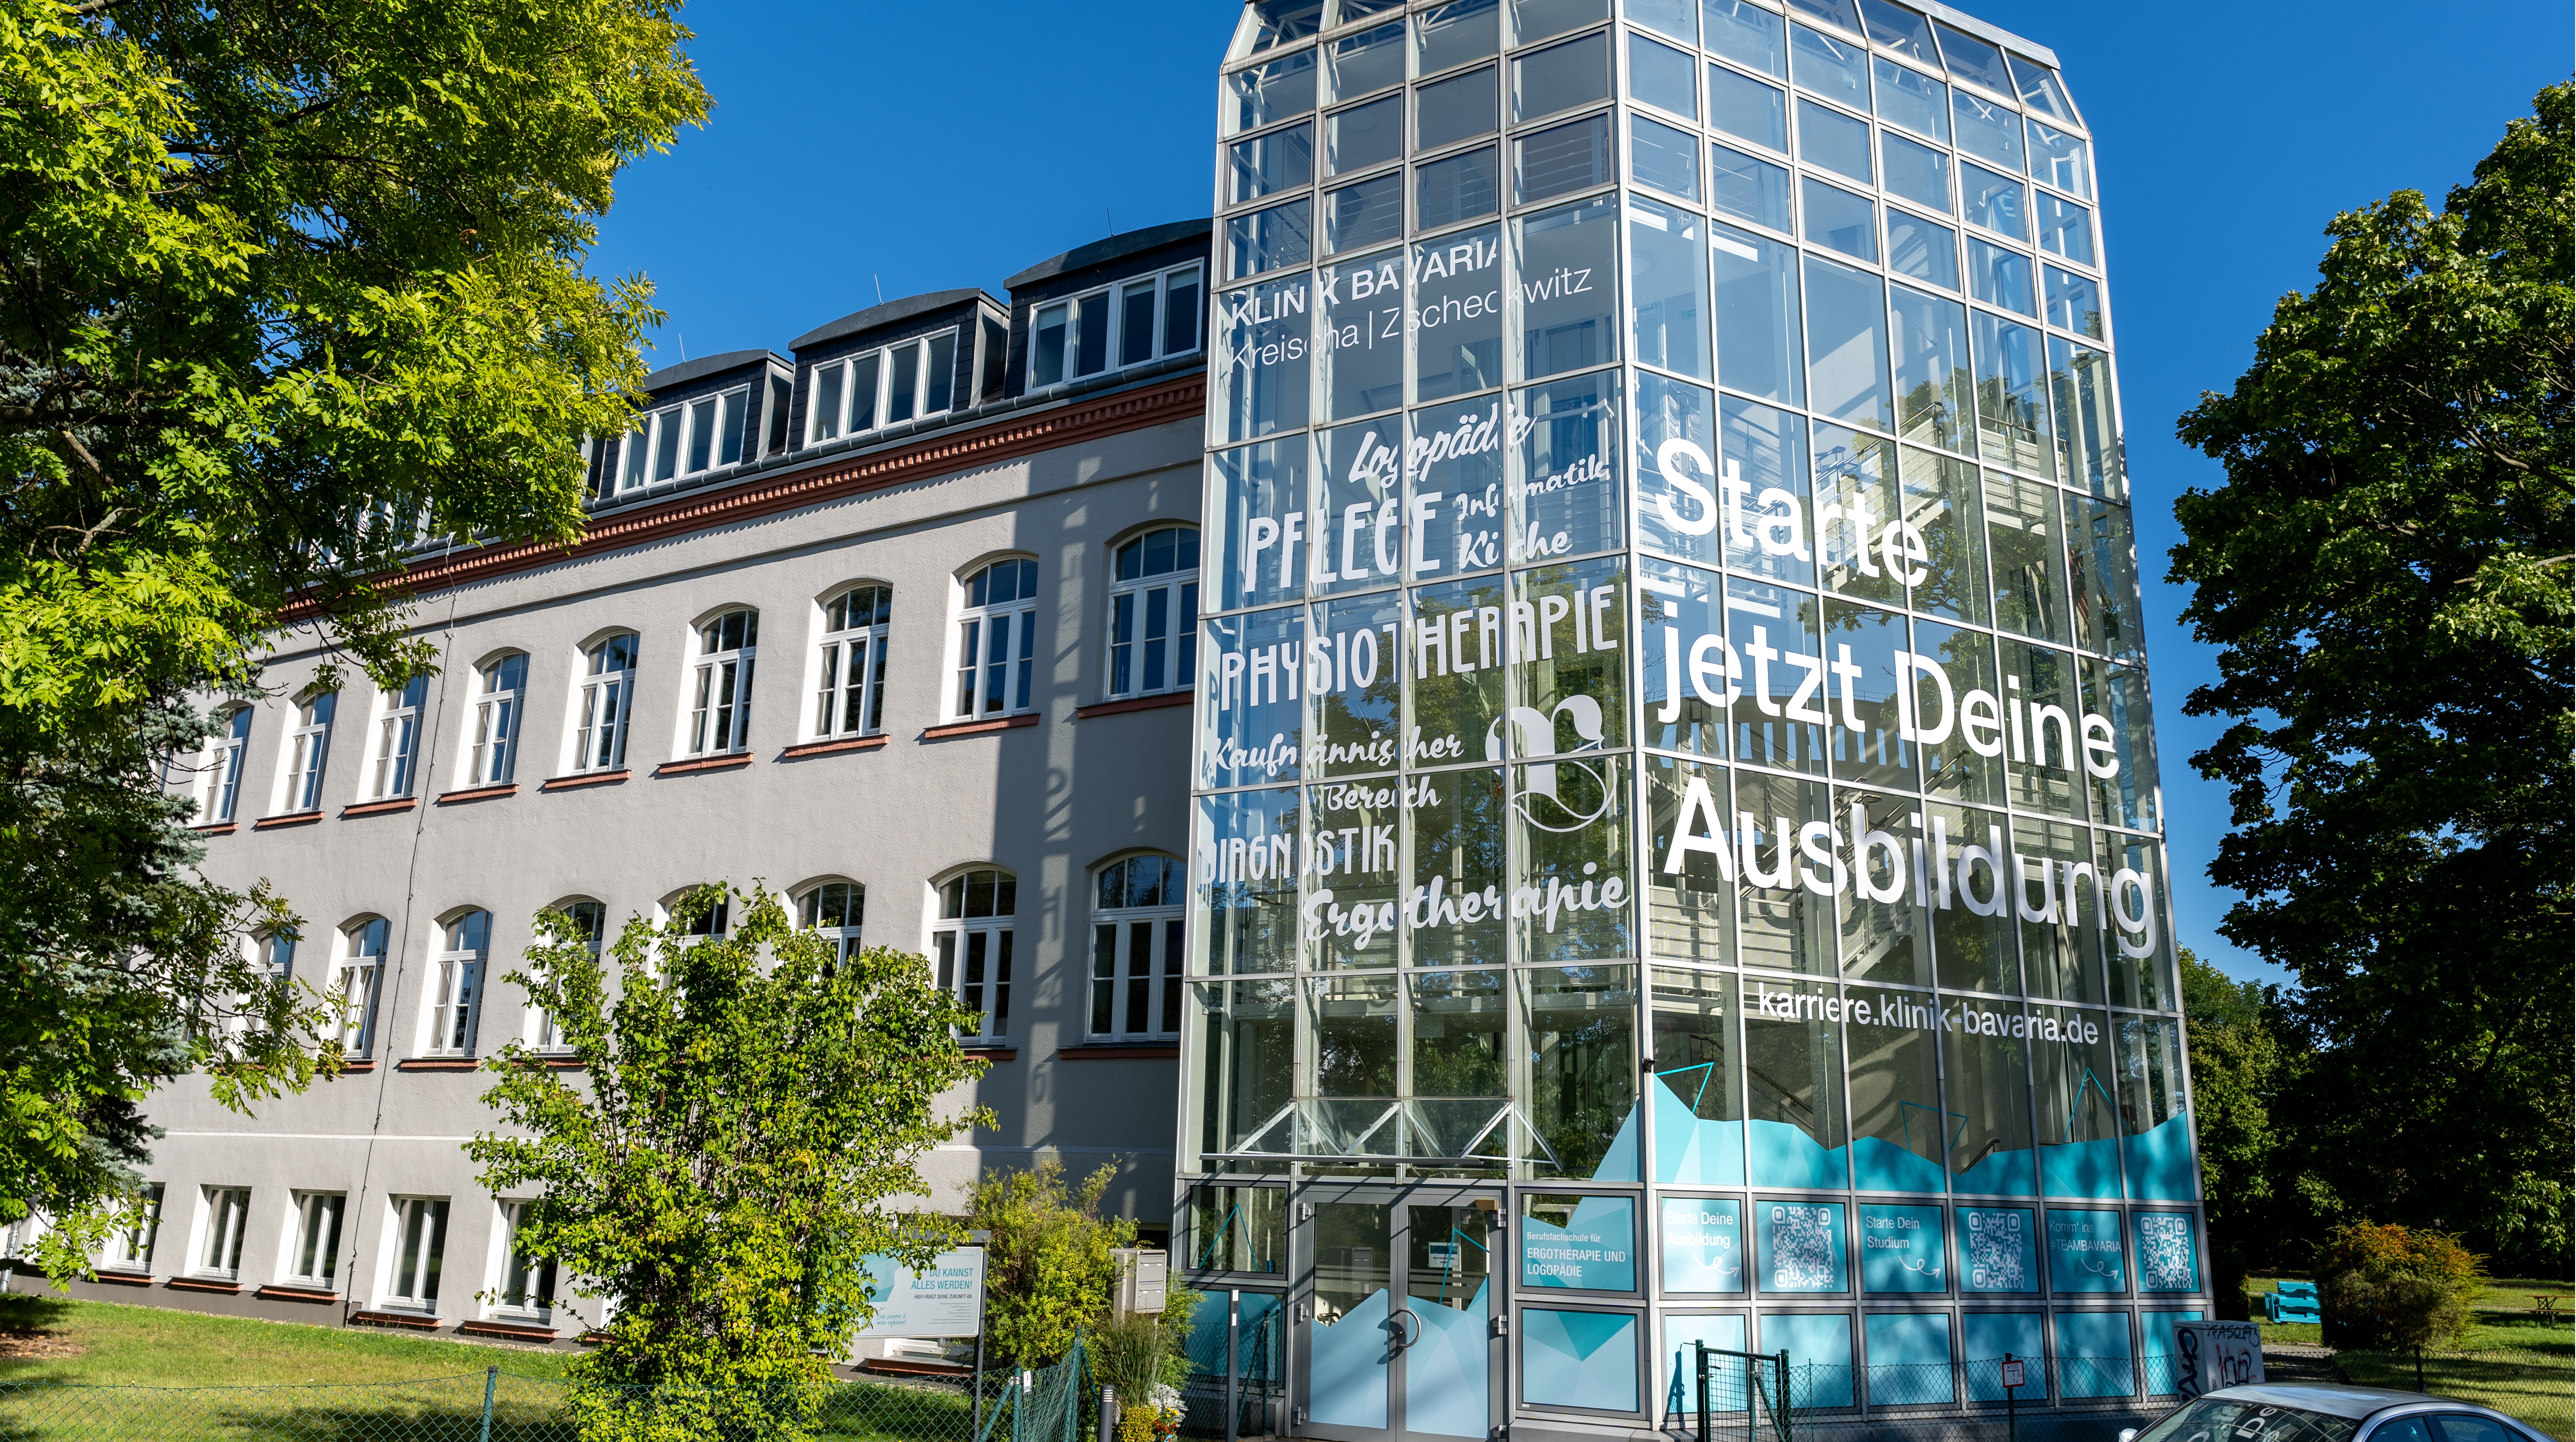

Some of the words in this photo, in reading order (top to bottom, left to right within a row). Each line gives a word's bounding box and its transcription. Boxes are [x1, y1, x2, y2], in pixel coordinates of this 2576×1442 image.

[1231, 276, 1341, 330] KLINK
[1352, 236, 1511, 300] BAVARIA
[1231, 324, 1359, 373] Kreischa
[1348, 402, 1537, 488] Logopäde
[1655, 438, 1928, 587] Starte
[1244, 491, 1442, 593] PFLEGE
[1221, 584, 1618, 711] PHYSIOTHERAPIE
[1657, 602, 1865, 732] jetzt
[1894, 649, 2120, 779] Deine
[1208, 725, 1464, 777] Kaufmännisher
[1663, 775, 2157, 960] Ausbildung
[1303, 862, 1631, 950] Ergotherapie
[1758, 982, 2099, 1045] karriere.klinik-bavaria.de
[1666, 1210, 1698, 1224] Starte
[1701, 1211, 1733, 1225] Deine
[1866, 1215, 1895, 1229] Starte
[1897, 1217, 1920, 1229] Dein
[2081, 1222, 2094, 1233] ins
[1527, 1231, 1588, 1242] Berufsfachschule
[1590, 1234, 1601, 1242] für
[1666, 1232, 1730, 1249] Ausbildung
[1867, 1235, 1909, 1248] Studium
[2051, 1239, 2122, 1252] #TEAMBAVARIA
[1527, 1247, 1601, 1261] ERGOTHERAPIE
[1604, 1251, 1625, 1262] UND
[1527, 1263, 1582, 1277] LOGOPÄDIE
[911, 1281, 935, 1290] ALLES
[937, 1280, 973, 1290] WERDEN!
[930, 1268, 940, 1277] DU
[943, 1268, 973, 1277] KANNST
